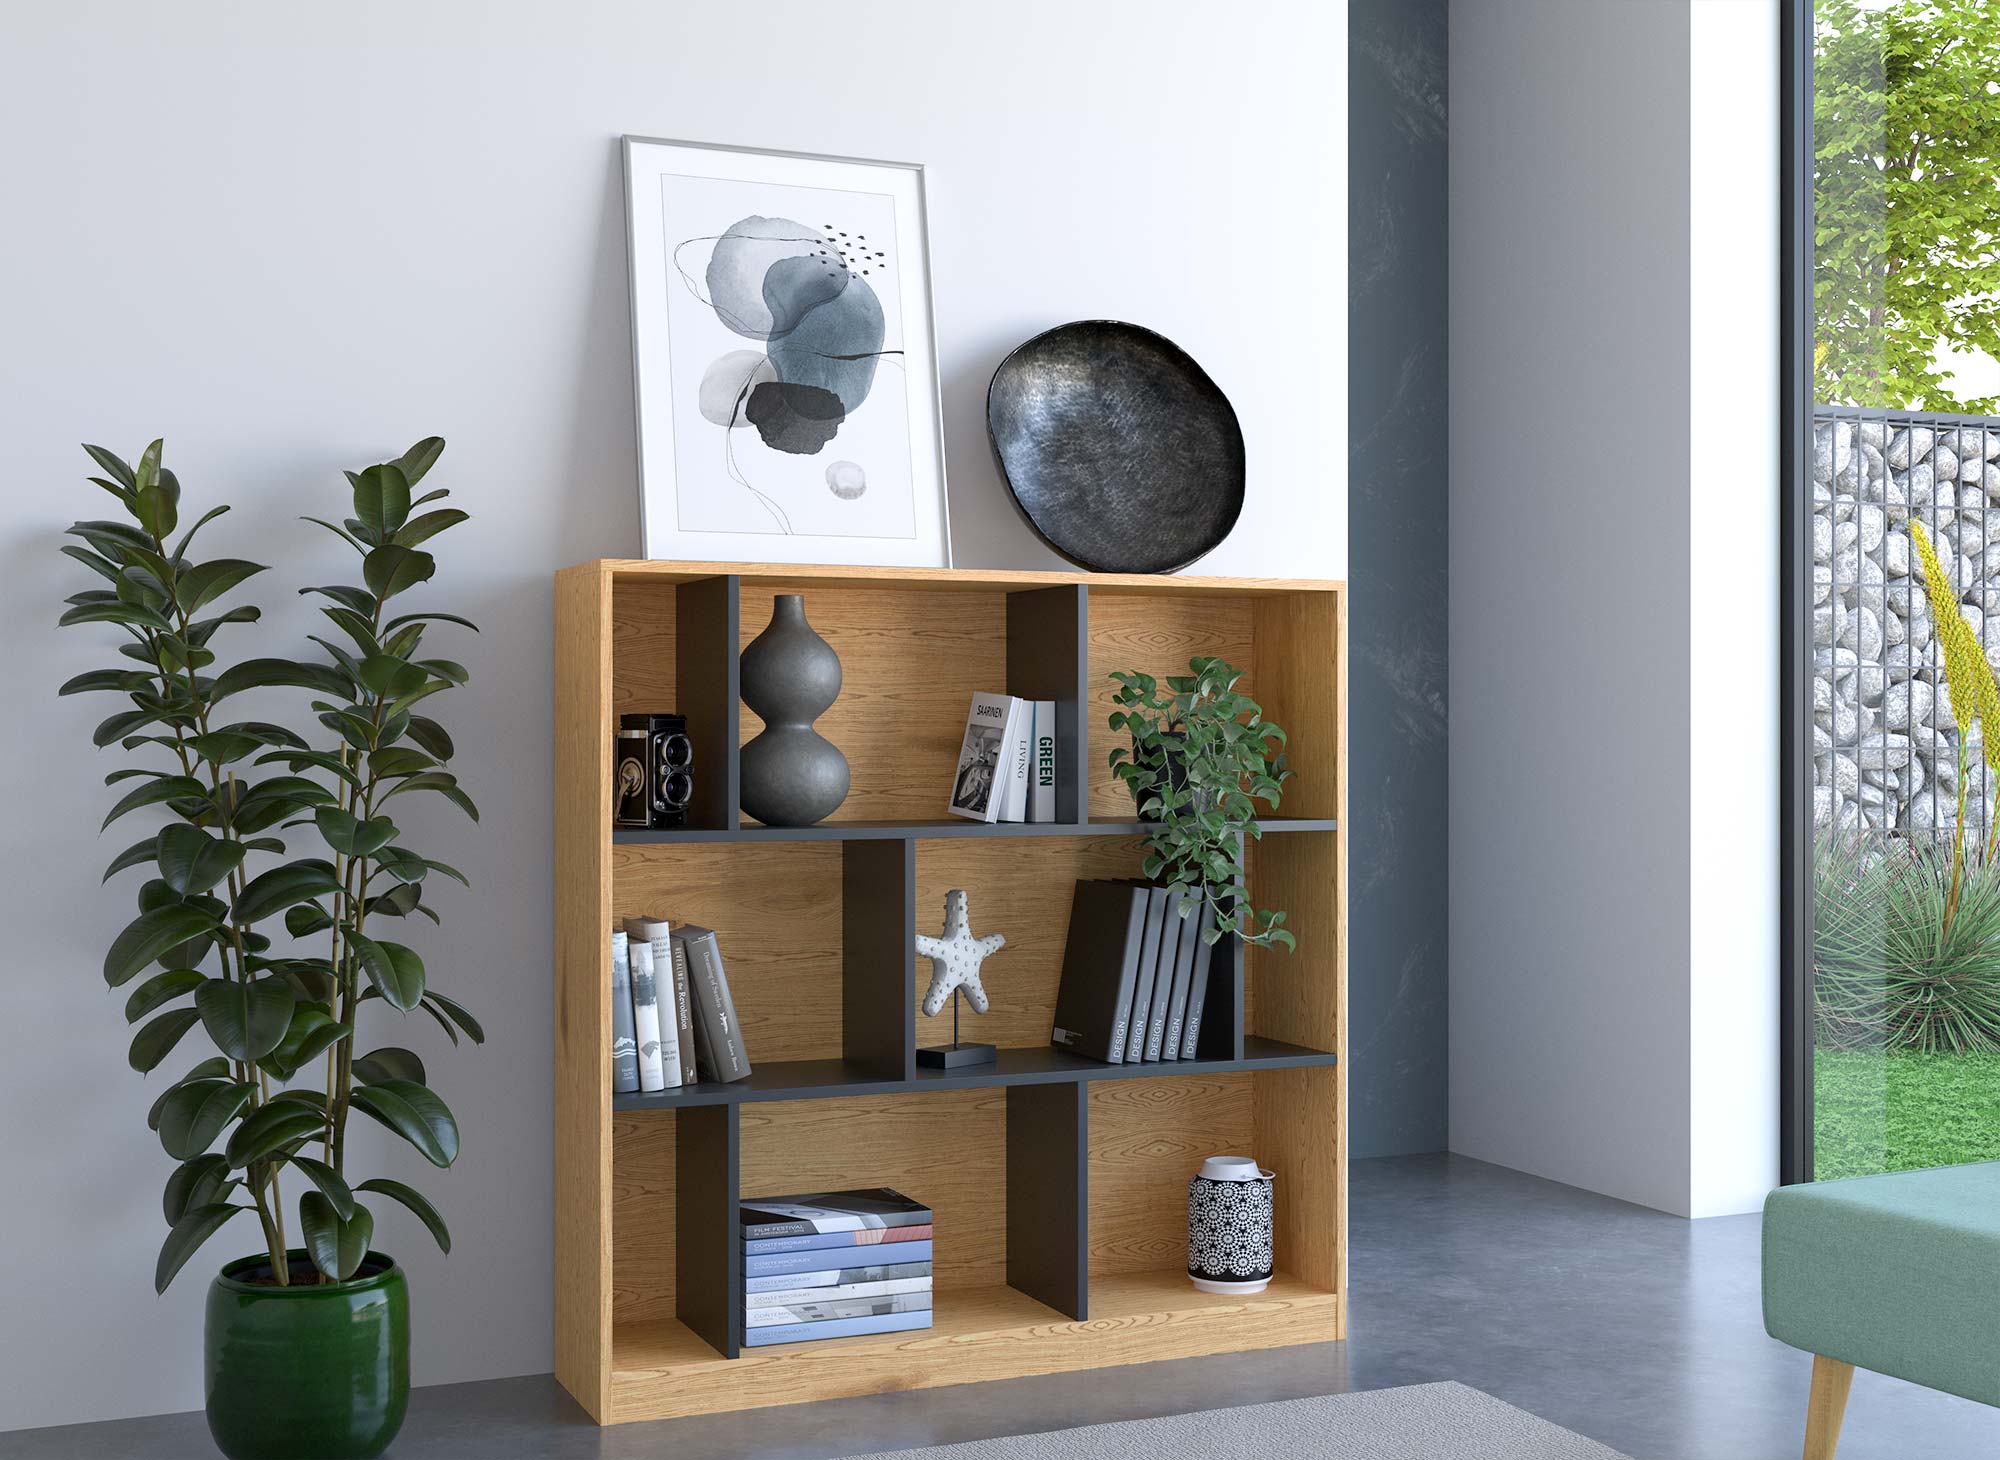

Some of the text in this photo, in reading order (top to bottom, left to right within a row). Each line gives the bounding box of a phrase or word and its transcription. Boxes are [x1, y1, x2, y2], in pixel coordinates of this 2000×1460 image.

[976, 704, 1004, 718] SAARINEN
[1018, 740, 1027, 779] LIVING
[1039, 736, 1053, 786] GREEN
[678, 991, 688, 1030] Revolution
[1113, 1021, 1126, 1058] DESIGN
[1131, 1020, 1144, 1057] DESIGN
[1150, 1019, 1163, 1056] DESIGN
[1168, 1018, 1181, 1055] DESIGN
[1186, 1017, 1199, 1054] DESIGN
[753, 1239, 811, 1248] CONTEMPORARY
[753, 1276, 811, 1286] CONTEMPORARY
[753, 1292, 811, 1302] CONTEMPORARY
